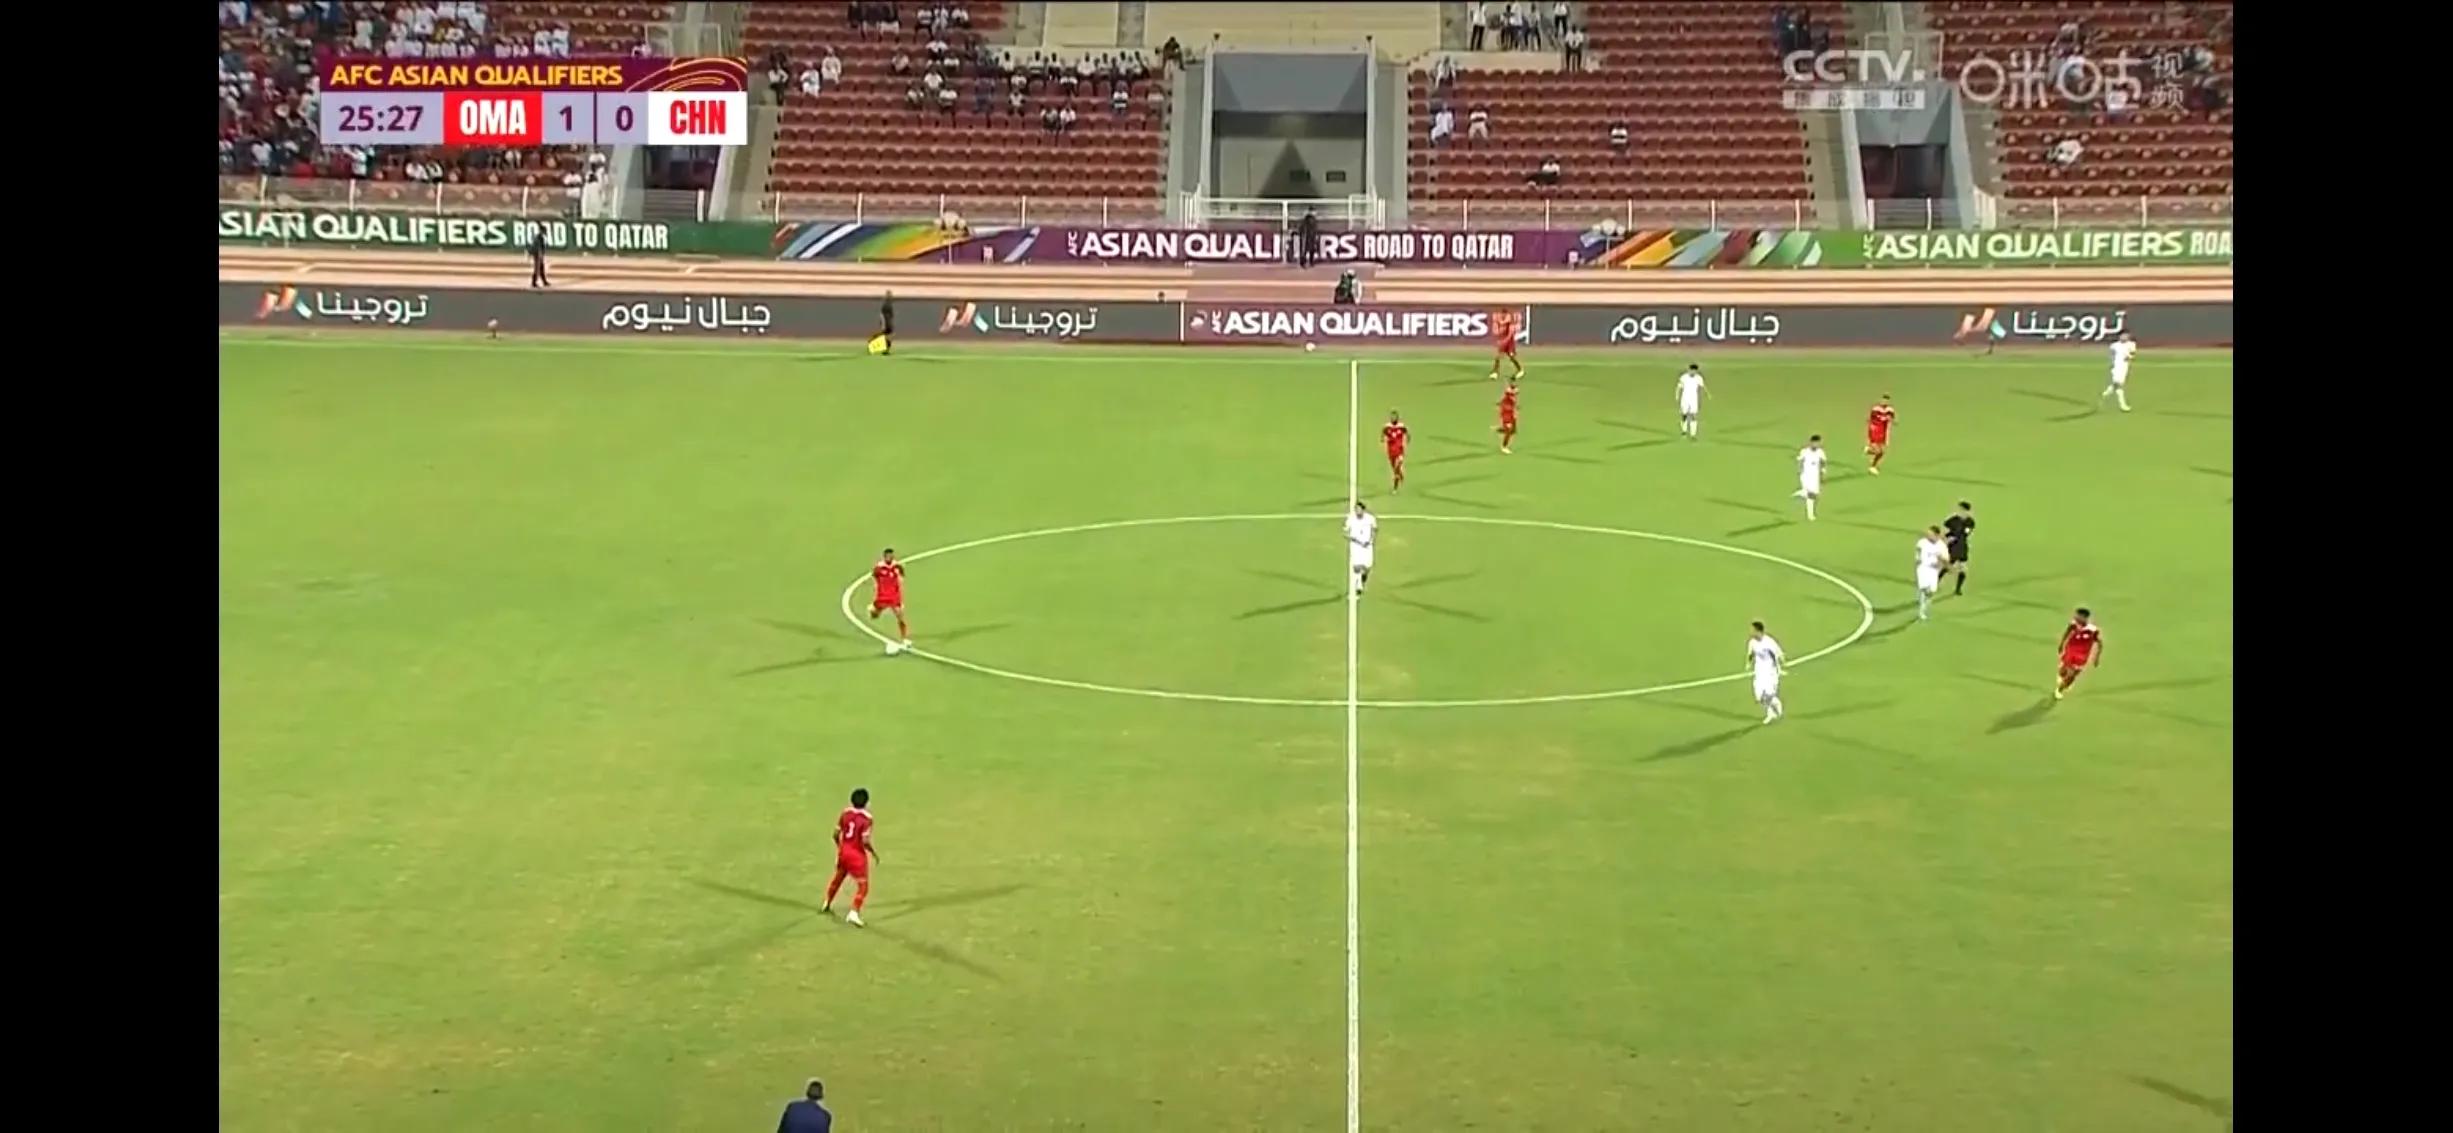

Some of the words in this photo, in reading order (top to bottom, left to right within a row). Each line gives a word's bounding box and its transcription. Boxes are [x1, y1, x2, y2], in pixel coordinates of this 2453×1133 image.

[219, 211, 306, 238] SIAN
[313, 214, 507, 245] QUALIFIERS
[573, 222, 598, 247] TO
[605, 223, 668, 249] QATAR
[1081, 231, 1178, 257] ASIAN
[1364, 233, 1415, 259] ROAD
[1421, 233, 1445, 259] TO
[1452, 234, 1514, 260] QATAR
[1875, 233, 1981, 259] ASIAN
[1986, 231, 2183, 258] QUALIFIERS
[316, 291, 428, 324] تروجينا
[603, 297, 691, 331] نيوم
[698, 296, 770, 332] جبال
[994, 305, 1098, 336] تروجينا
[1223, 310, 1315, 335] ASIAN
[1320, 311, 1488, 336] QUALIFIERS
[1611, 308, 1700, 343] نيوم
[1707, 307, 1780, 344] جبال
[2013, 310, 2126, 341] تروجينا
